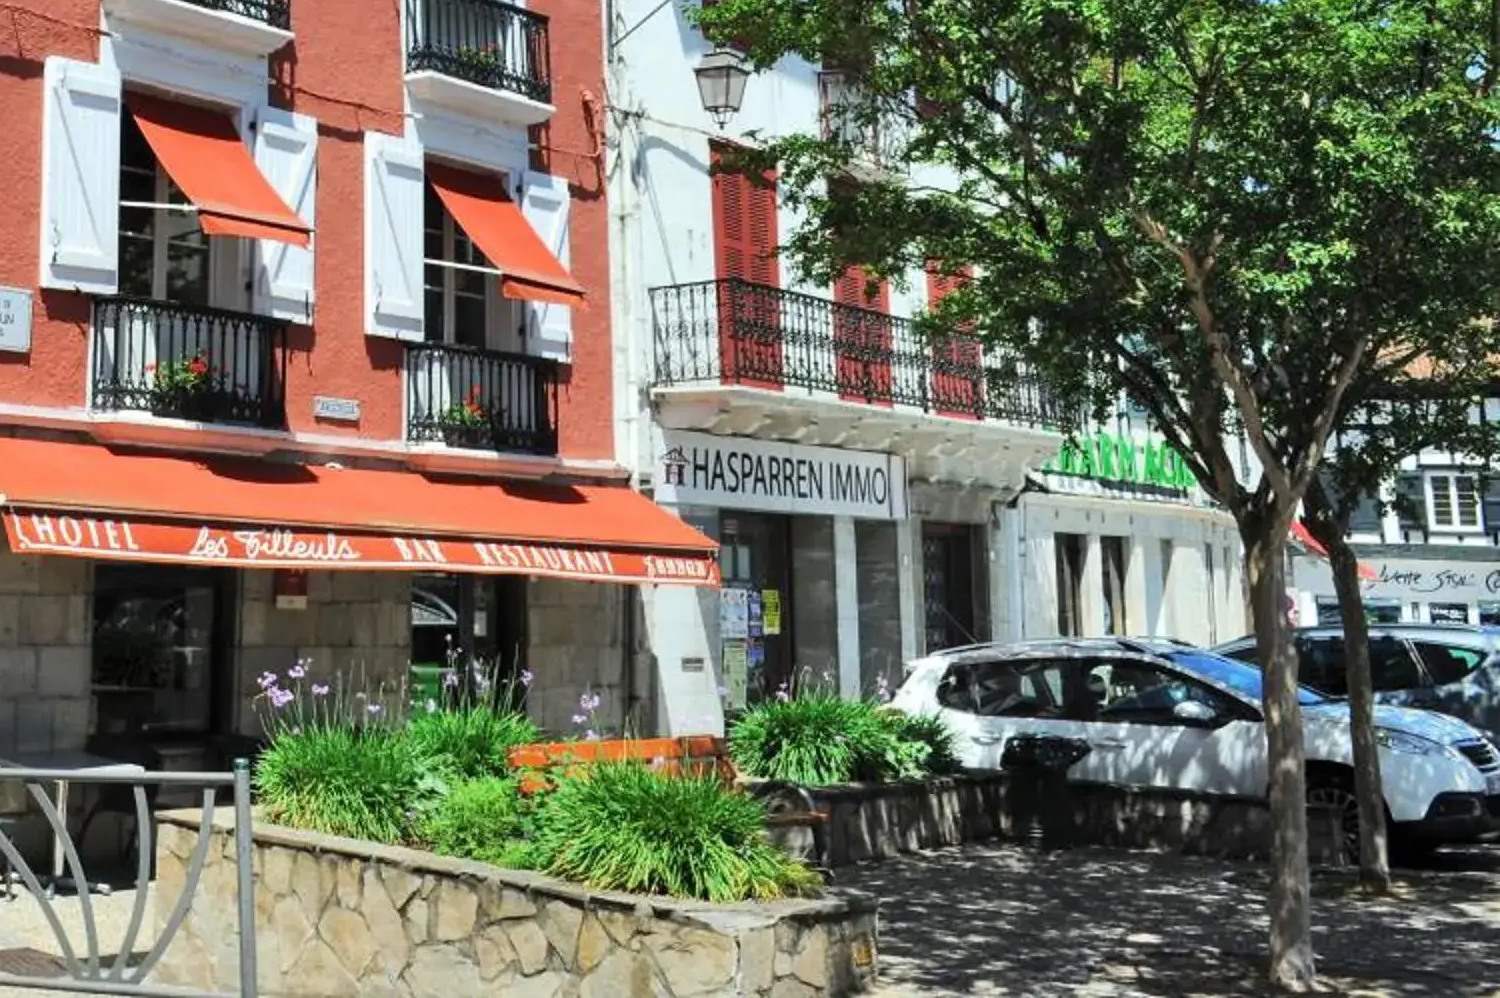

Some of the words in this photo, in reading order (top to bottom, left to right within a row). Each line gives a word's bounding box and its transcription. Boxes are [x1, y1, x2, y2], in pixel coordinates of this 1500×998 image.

[692, 447, 824, 499] HASPARREN
[828, 461, 887, 505] IMMO
[32, 514, 139, 551] HOTEL
[234, 530, 361, 561] Tilleuls
[393, 536, 447, 564] BAR
[473, 542, 614, 575] RESTAURANT
